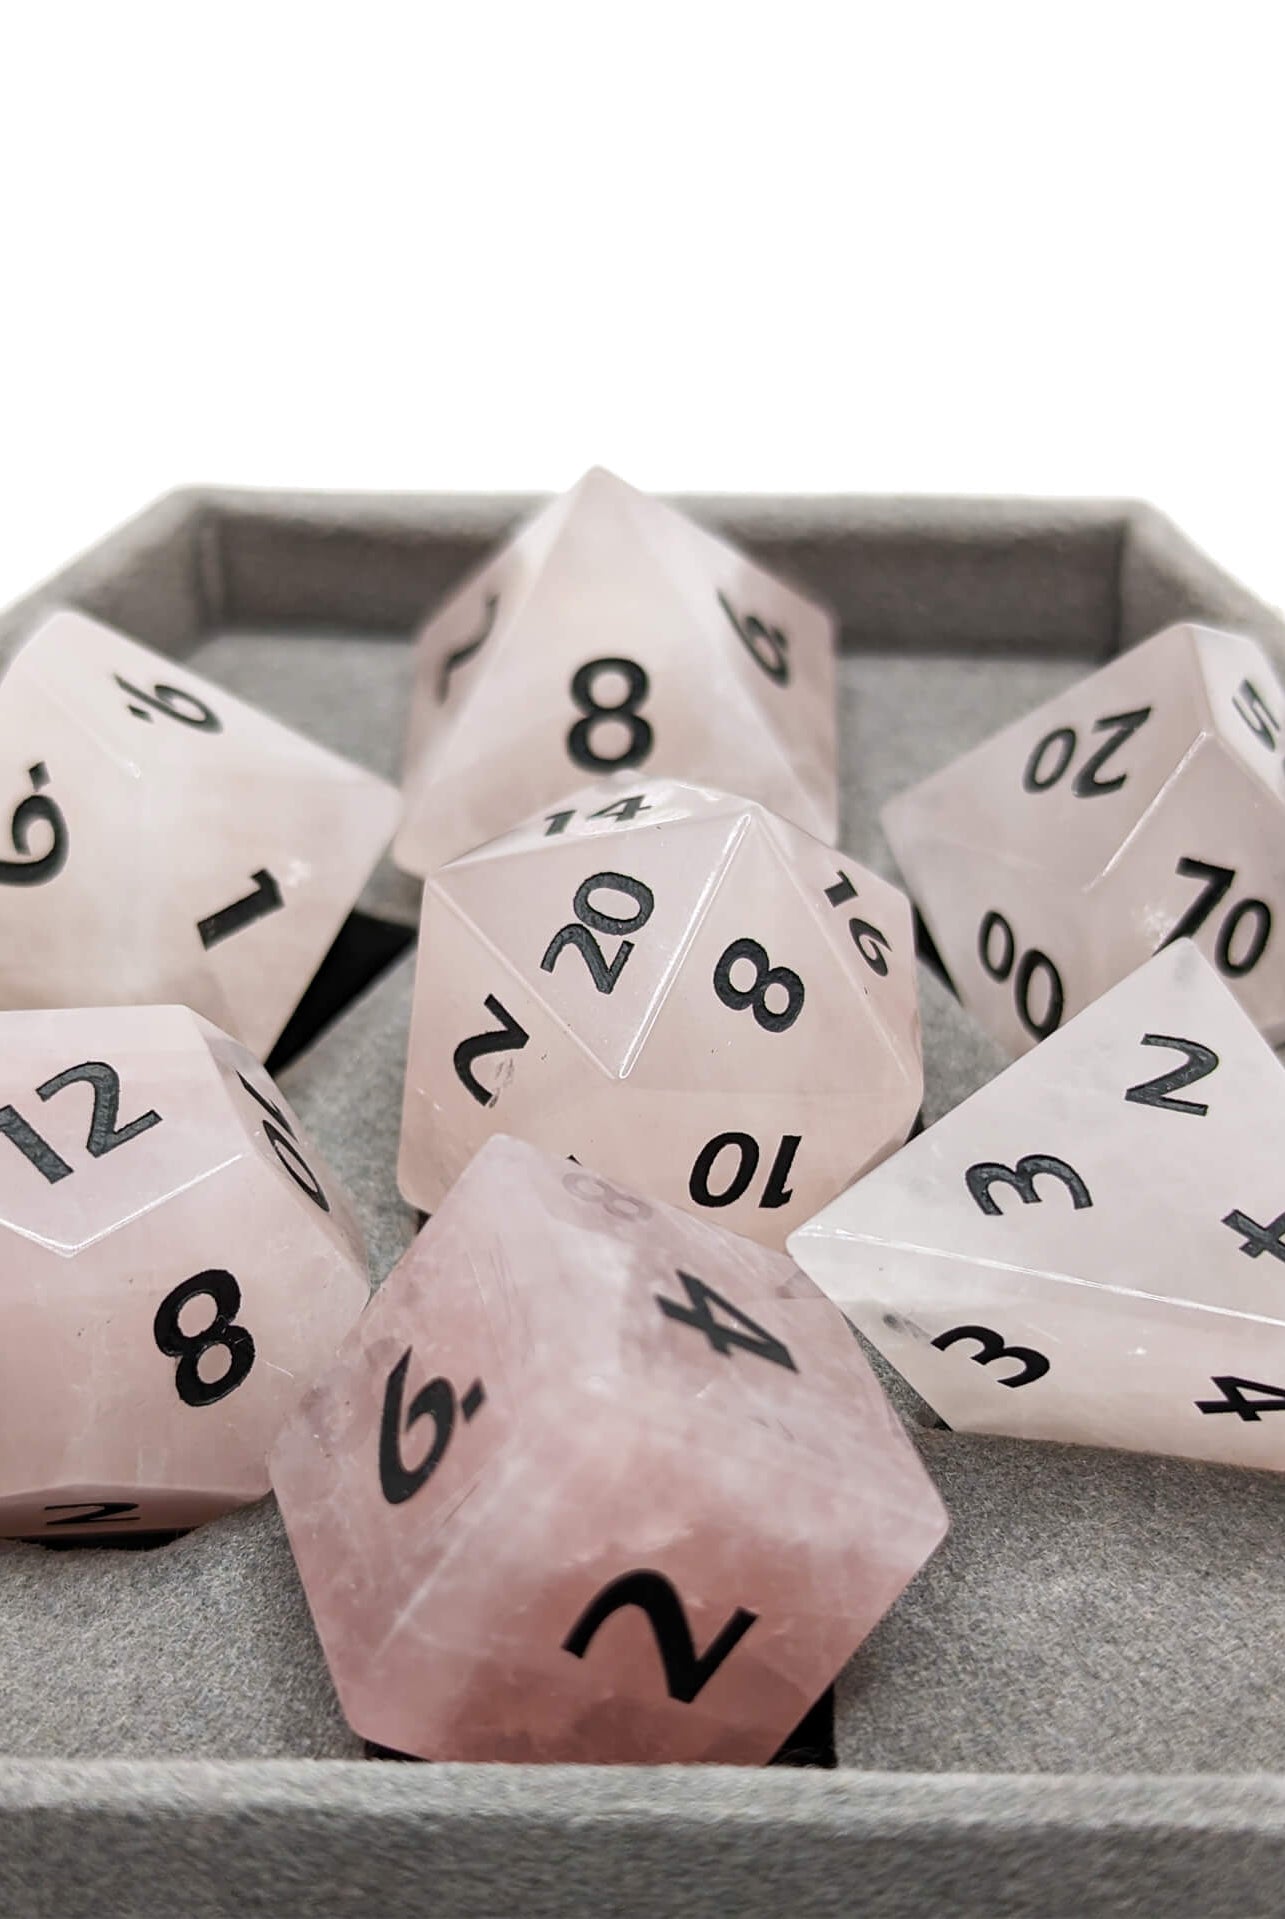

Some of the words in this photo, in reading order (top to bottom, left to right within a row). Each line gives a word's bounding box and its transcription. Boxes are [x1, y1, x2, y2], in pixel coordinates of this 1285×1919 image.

[566, 656, 654, 774] 8
[1023, 706, 1152, 798] 20
[544, 795, 653, 837] 14
[197, 868, 285, 951] 1
[541, 871, 655, 995] 20
[823, 870, 893, 977] 16
[713, 938, 805, 1033] 8
[978, 910, 1064, 1043] 00
[0, 1061, 163, 1184] 12
[1125, 1033, 1219, 1117] 2
[689, 1132, 802, 1209] 10
[965, 1154, 1093, 1215] 3
[154, 1269, 255, 1407] 8
[655, 1269, 799, 1374] 4
[931, 1325, 1050, 1388] 3
[1194, 1376, 1285, 1421] 4
[563, 1568, 760, 1704] 2
